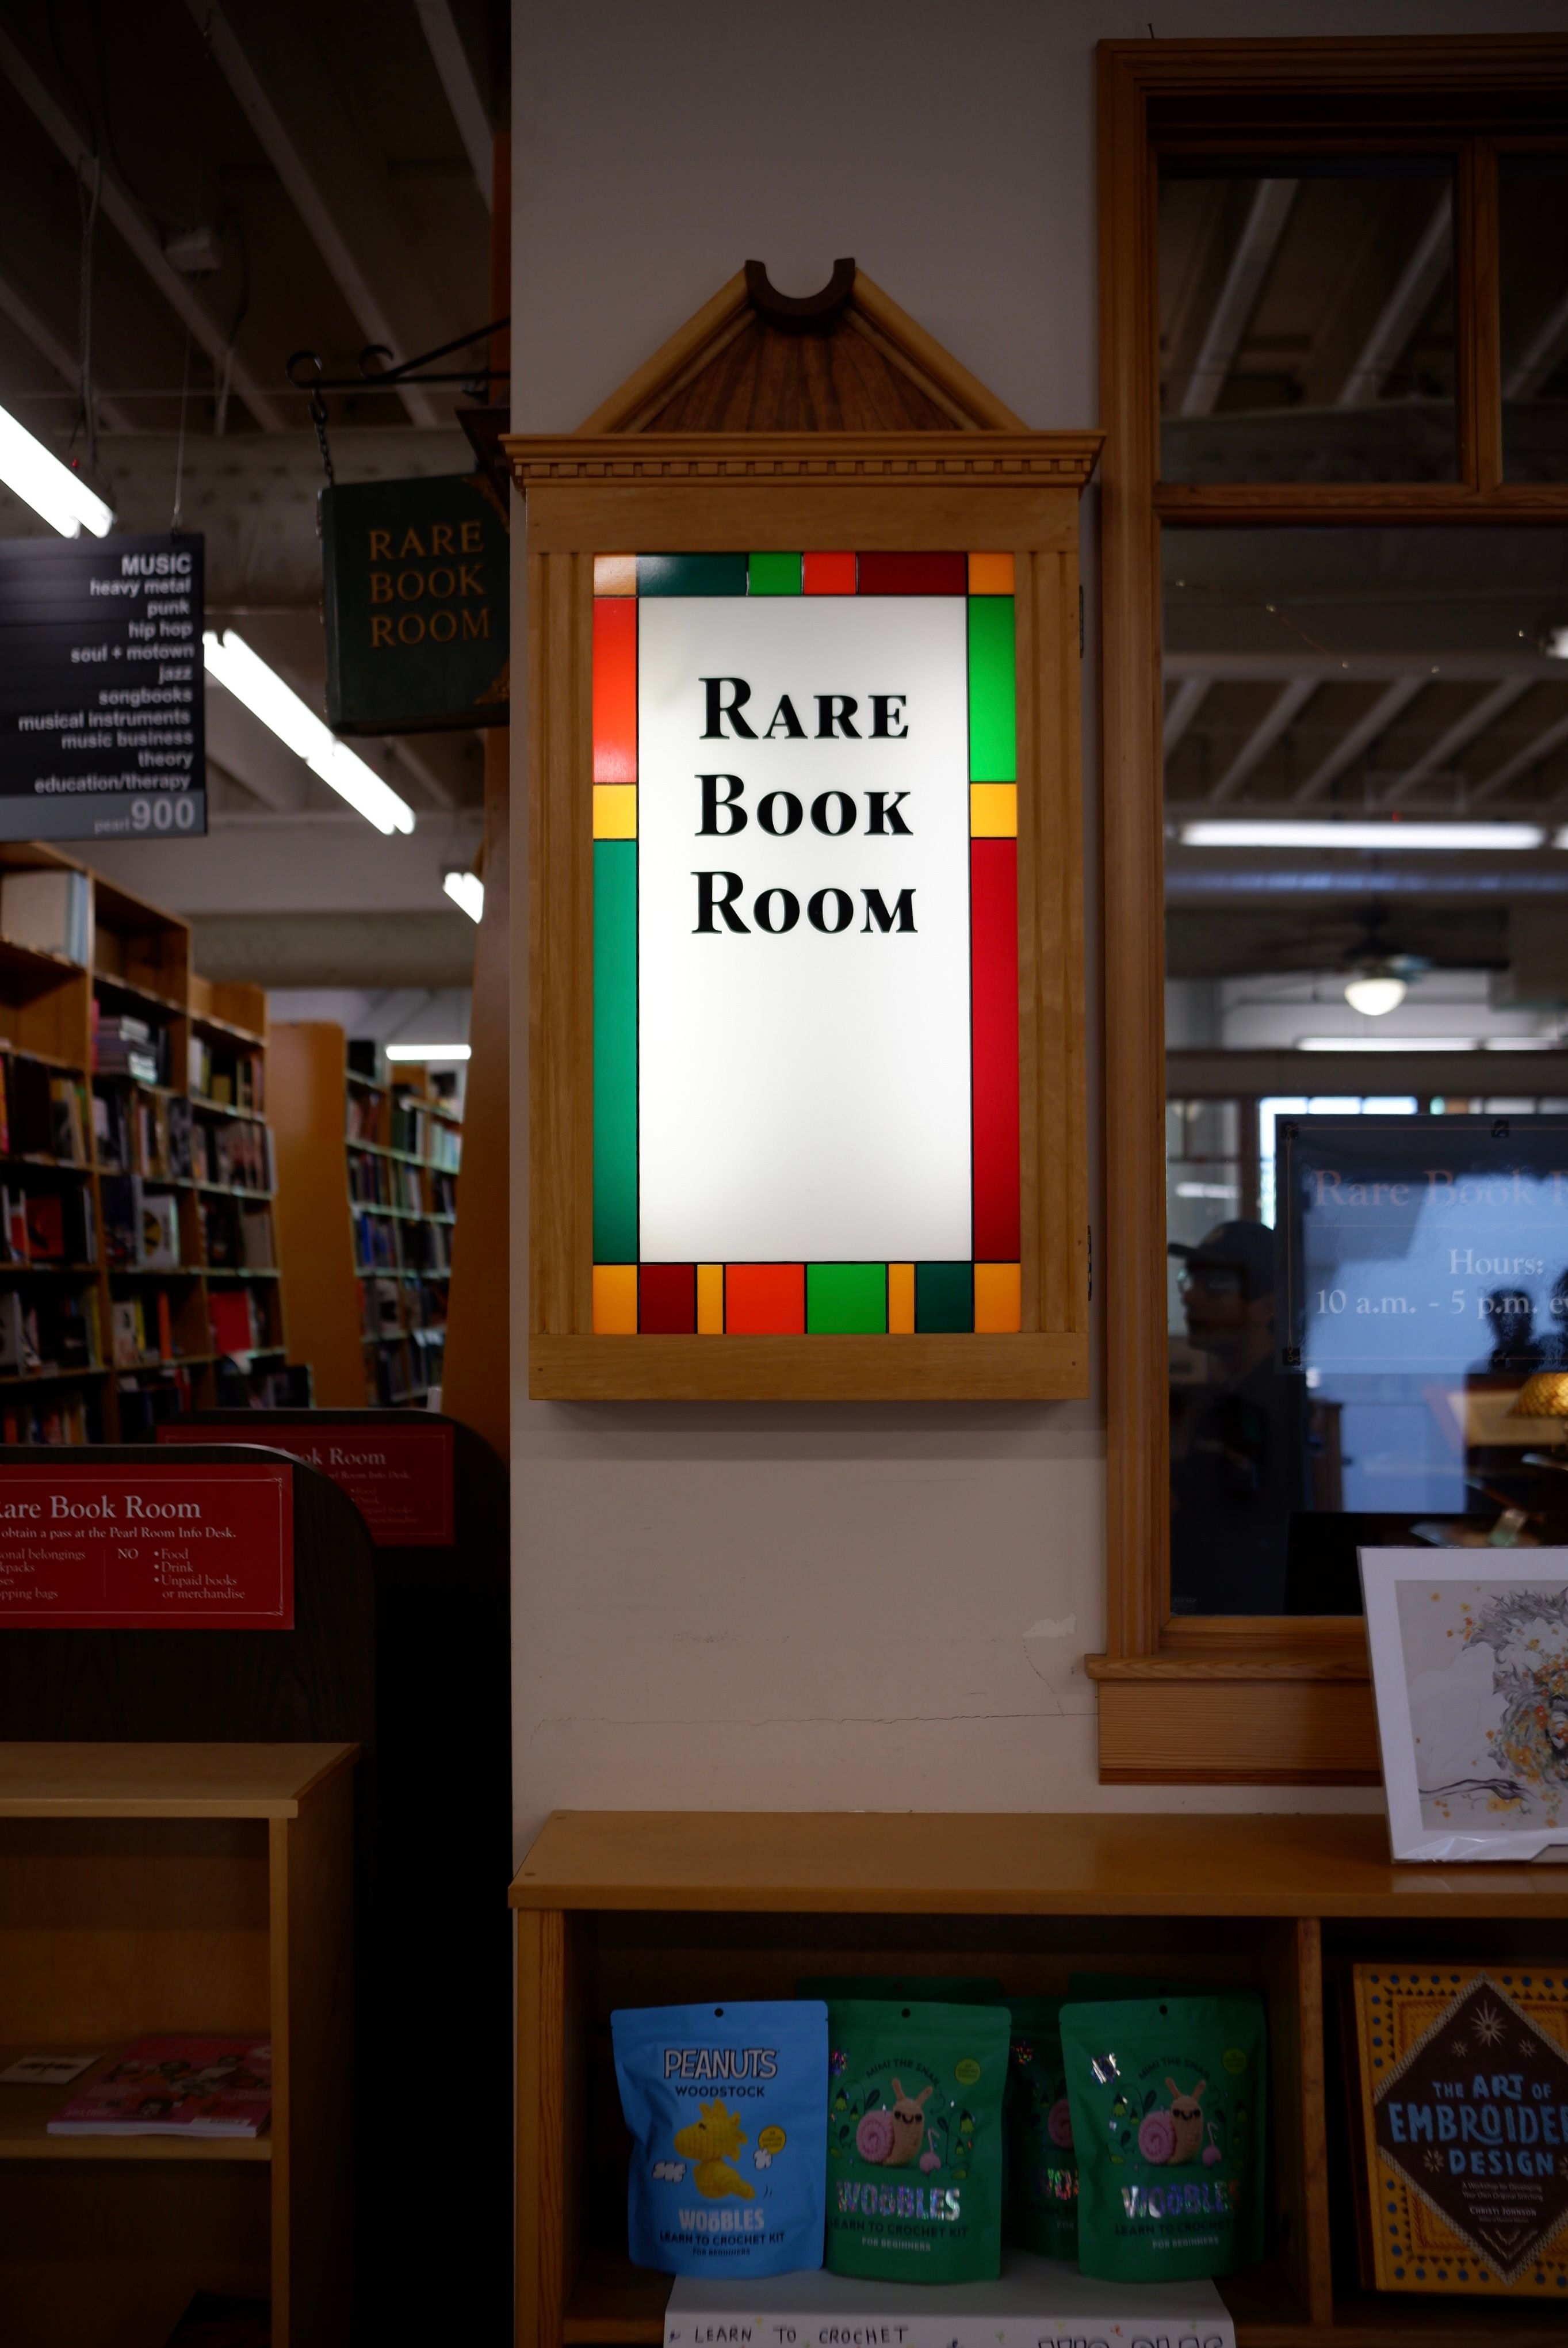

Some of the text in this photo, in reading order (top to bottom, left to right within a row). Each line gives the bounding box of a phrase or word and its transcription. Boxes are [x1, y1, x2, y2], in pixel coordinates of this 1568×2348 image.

[368, 521, 484, 562] RARE
[121, 553, 192, 576] MUSIC
[90, 575, 192, 598] heavy metal
[370, 564, 487, 604] BOOK
[147, 597, 190, 619] punk
[129, 619, 194, 641] hip hop
[370, 607, 489, 648] ROOM
[71, 643, 108, 663] soul
[127, 642, 195, 661] motown
[158, 663, 193, 685] jazz
[99, 685, 193, 708] songbooks
[18, 707, 191, 732] musical instruments
[61, 728, 194, 749] music business
[137, 749, 194, 769] theory
[34, 770, 191, 793] education/therapy
[131, 797, 195, 830] 900
[1311, 1169, 1409, 1207] Rare
[1423, 1170, 1538, 1207] Book
[1448, 1249, 1543, 1275] Hours:
[1316, 1289, 1346, 1315] 10
[1356, 1296, 1416, 1315] a.m.
[1450, 1289, 1465, 1315] 5
[1477, 1296, 1538, 1319] p.m.
[328, 1446, 387, 1465] Room
[48, 1495, 117, 1519] Book
[123, 1495, 202, 1519] Room
[1, 1526, 237, 1541] obtain a pass at the Pearl Room Info Desk.
[0, 1547, 86, 1562] onal belongings
[117, 1547, 189, 1560] NO Food
[161, 1561, 194, 1573] Drink
[161, 1574, 238, 1588] Unpaid books
[0, 1586, 59, 1601] pping bags
[162, 1587, 246, 1599] or merchandise
[664, 2048, 777, 2079] PEANUTS
[893, 2059, 914, 2069] THE
[675, 2086, 764, 2097] WOODSTOCK
[1432, 2073, 1552, 2101] THE ART OF
[1448, 2147, 1555, 2177] DESIGN
[1468, 2205, 1537, 2217] CHRISTI JOHNSON
[660, 2231, 784, 2246] LEARN TO CROCHET KIT
[869, 2220, 884, 2234] TO
[888, 2223, 945, 2238] CROCHET
[950, 2227, 968, 2238] KIT
[1115, 2223, 1154, 2236] LEARN
[1159, 2223, 1174, 2234] TO
[695, 2325, 909, 2344] LEARN TO CROCHET
